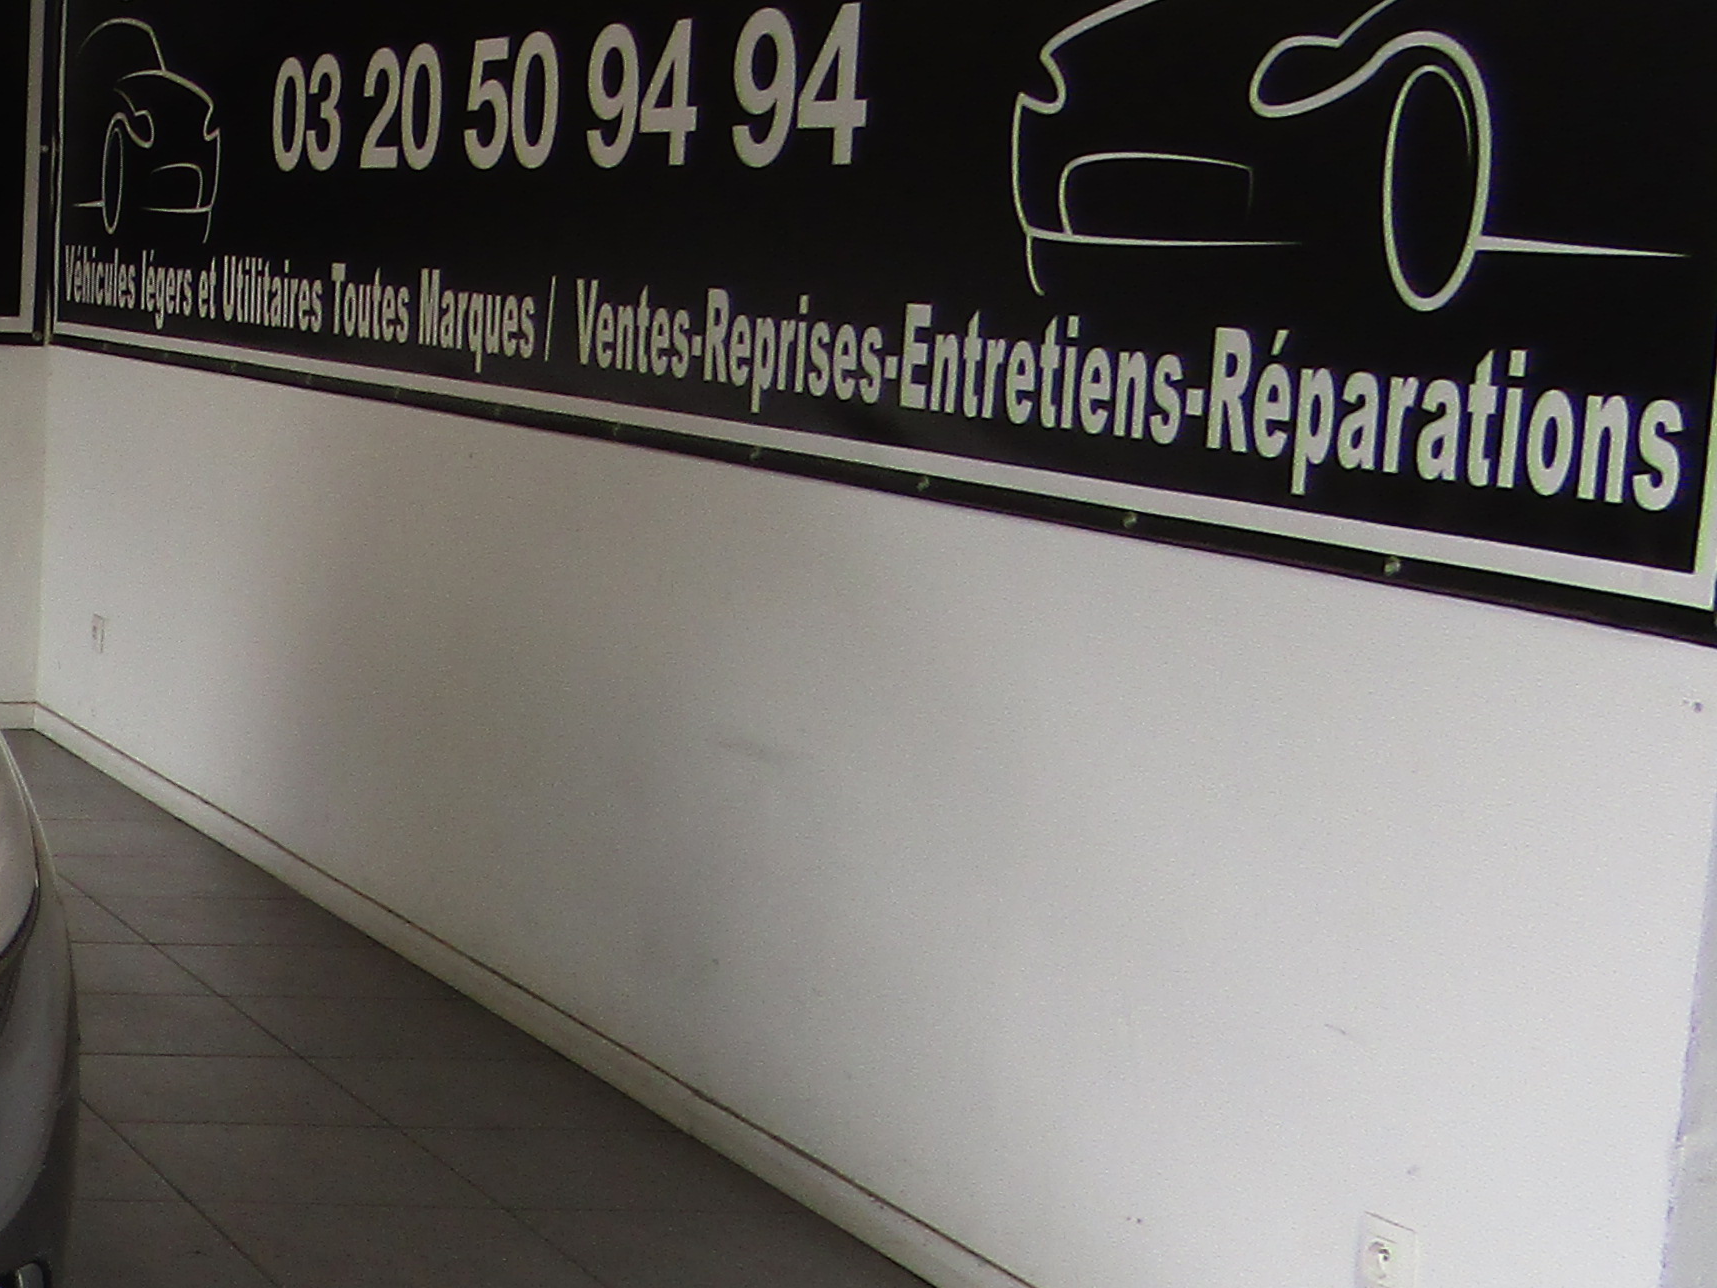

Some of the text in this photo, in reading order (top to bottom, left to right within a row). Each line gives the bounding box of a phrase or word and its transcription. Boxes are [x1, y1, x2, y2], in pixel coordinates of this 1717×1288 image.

[271, 1, 869, 172] 03 20 50 94 94
[65, 244, 136, 310] Véhicules
[141, 250, 192, 330] légers
[198, 257, 216, 320] et
[222, 255, 323, 333] Utilitaires
[331, 262, 410, 344] Toutes
[418, 267, 535, 373] Marques
